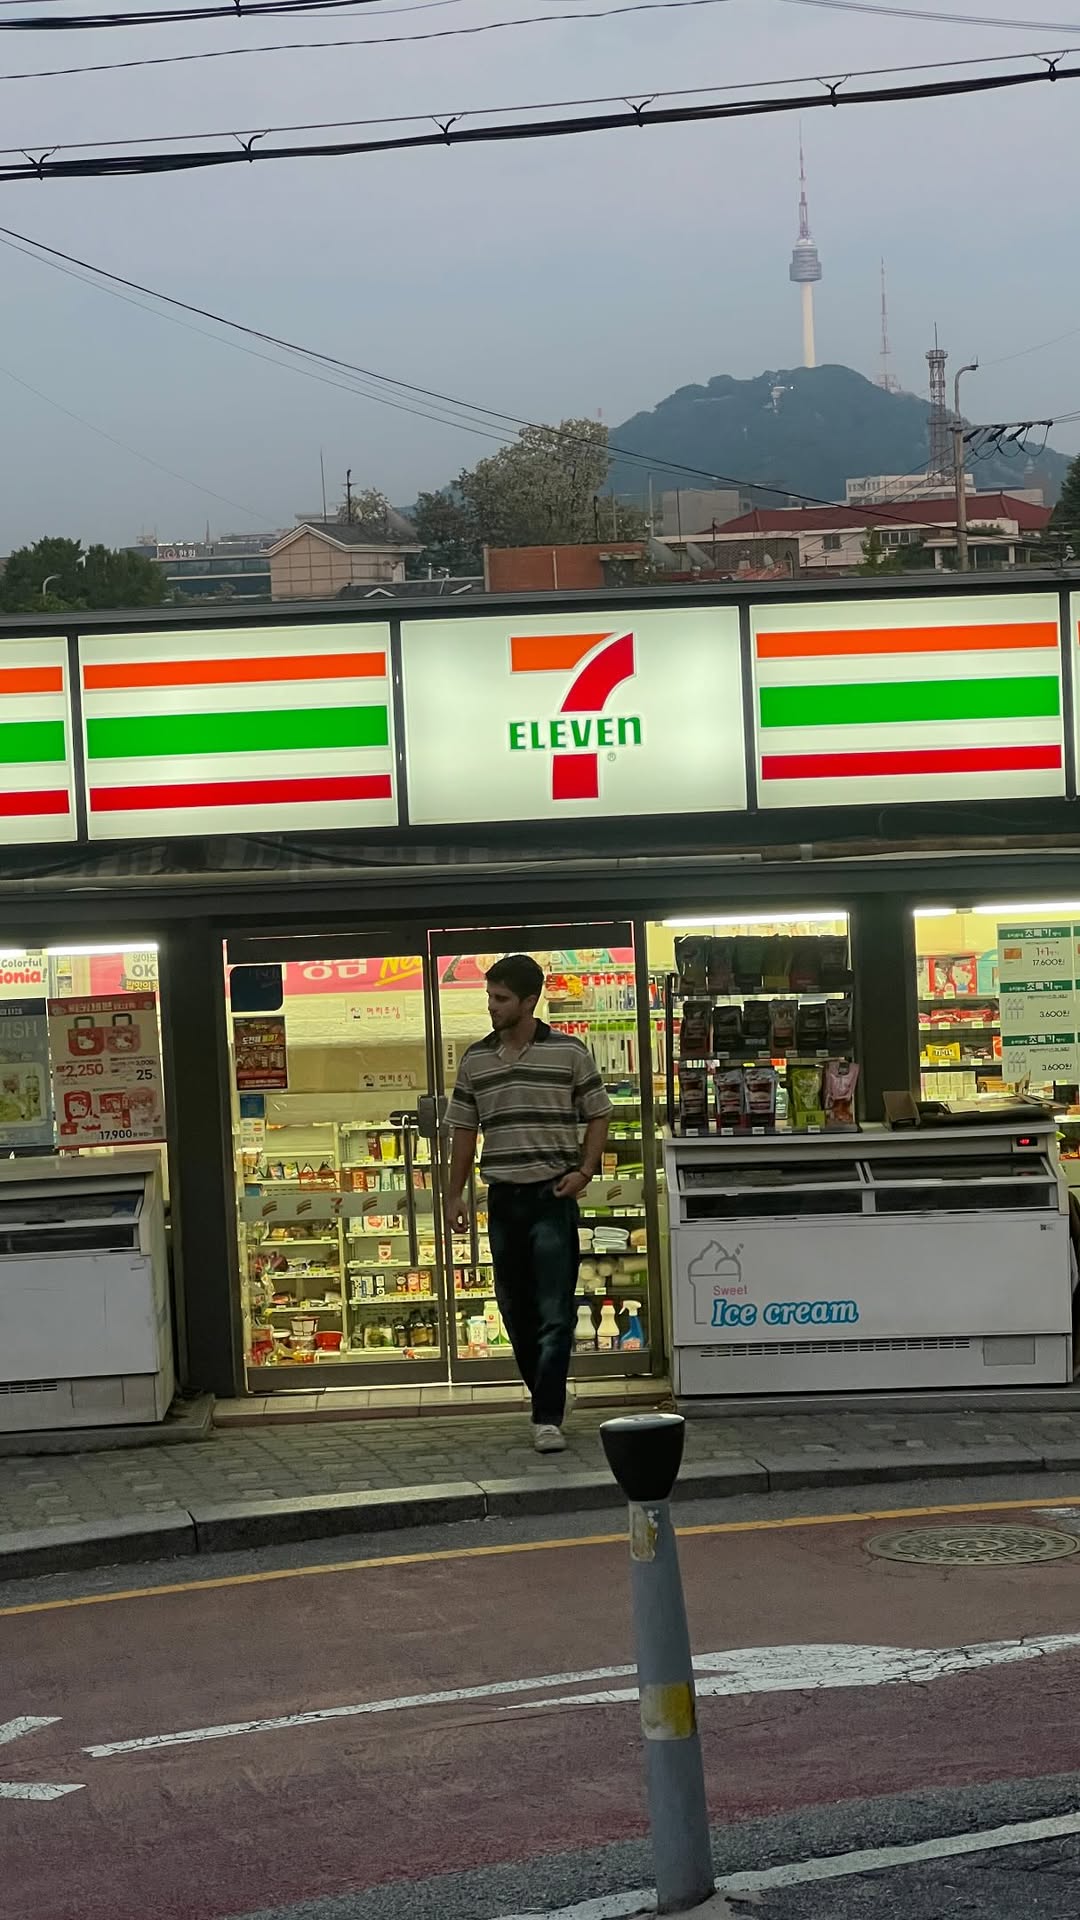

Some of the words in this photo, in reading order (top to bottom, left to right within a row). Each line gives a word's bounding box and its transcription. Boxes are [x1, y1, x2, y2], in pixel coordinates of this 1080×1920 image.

[511, 632, 635, 800] 7
[1, 957, 42, 968] Colorful
[131, 964, 156, 977] OK
[713, 1285, 749, 1297] Sweet
[711, 1298, 757, 1327] Ice
[763, 1299, 860, 1326] cream
